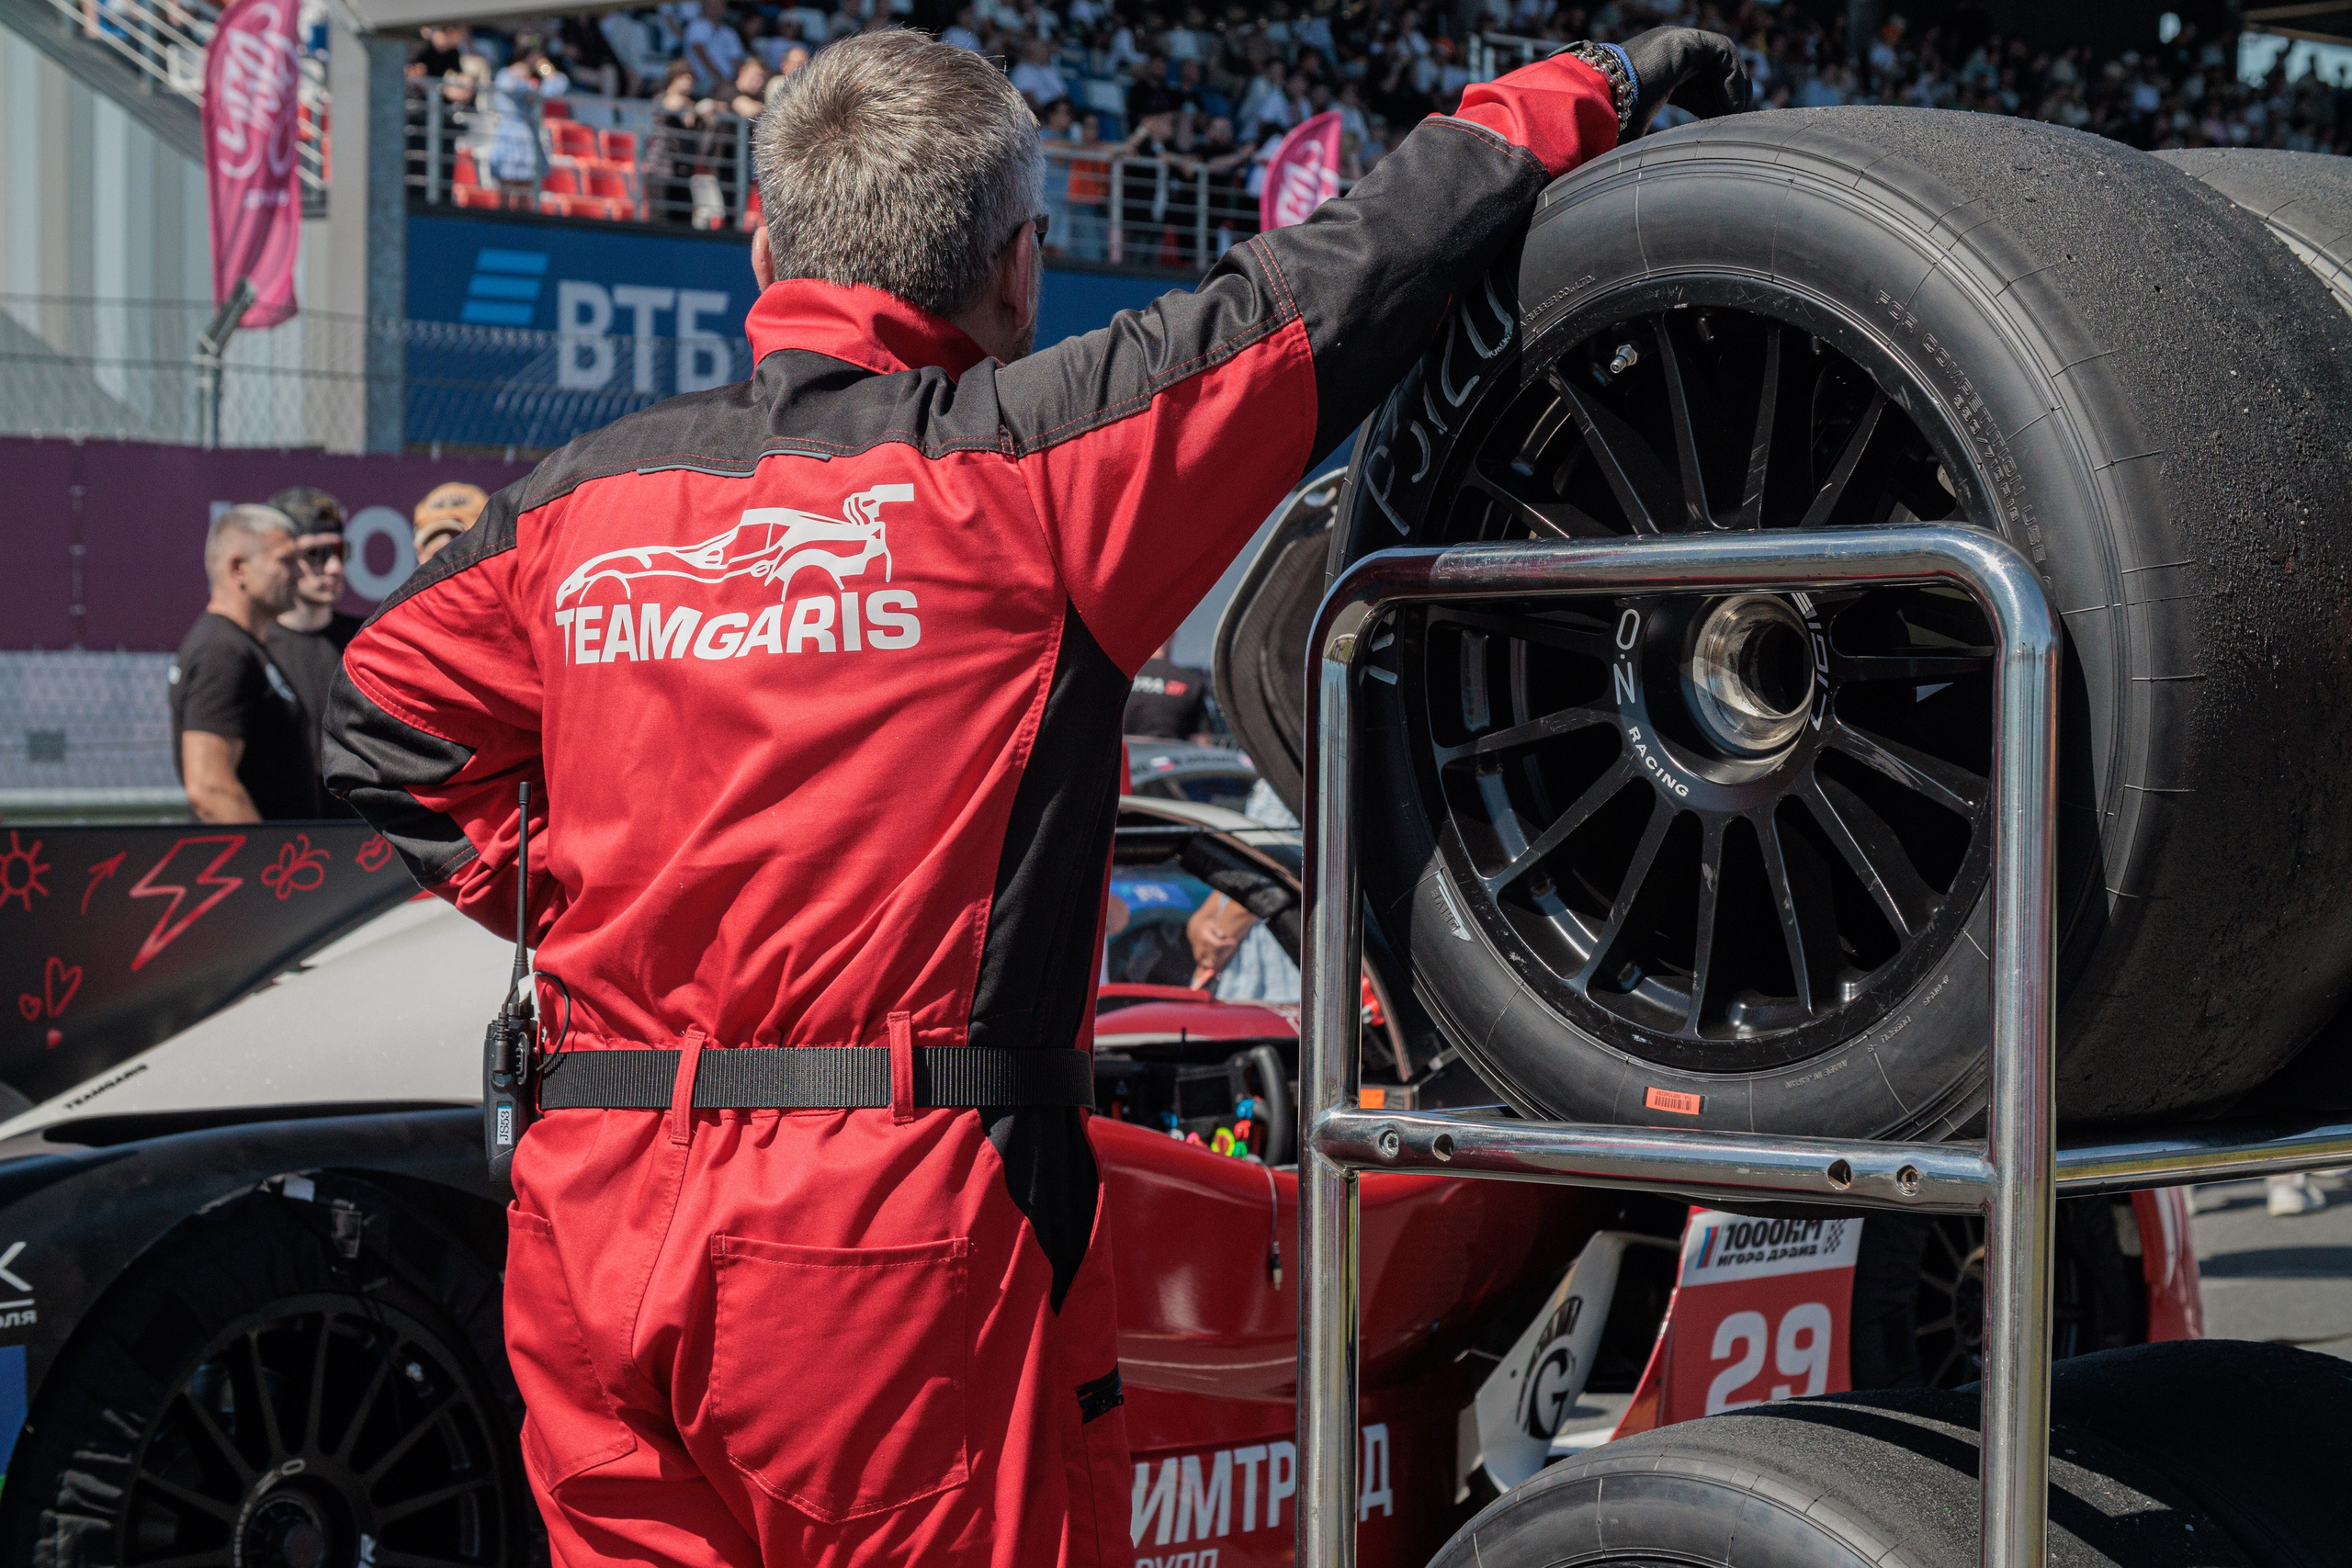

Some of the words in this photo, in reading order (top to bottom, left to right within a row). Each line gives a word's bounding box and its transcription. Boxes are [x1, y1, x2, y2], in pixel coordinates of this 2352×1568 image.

[558, 281, 731, 392] ВТБ
[1525, 295, 1559, 323] RUBBER
[1575, 275, 1596, 290] LTD.
[1875, 289, 1918, 333] FOR
[1922, 333, 2026, 498] COMPETITION
[2022, 506, 2048, 564] USE
[1628, 726, 1690, 798] RACING
[499, 1111, 510, 1141] JS53
[1704, 1302, 1832, 1416] 29
[1130, 1423, 1394, 1550] ИМТРД
